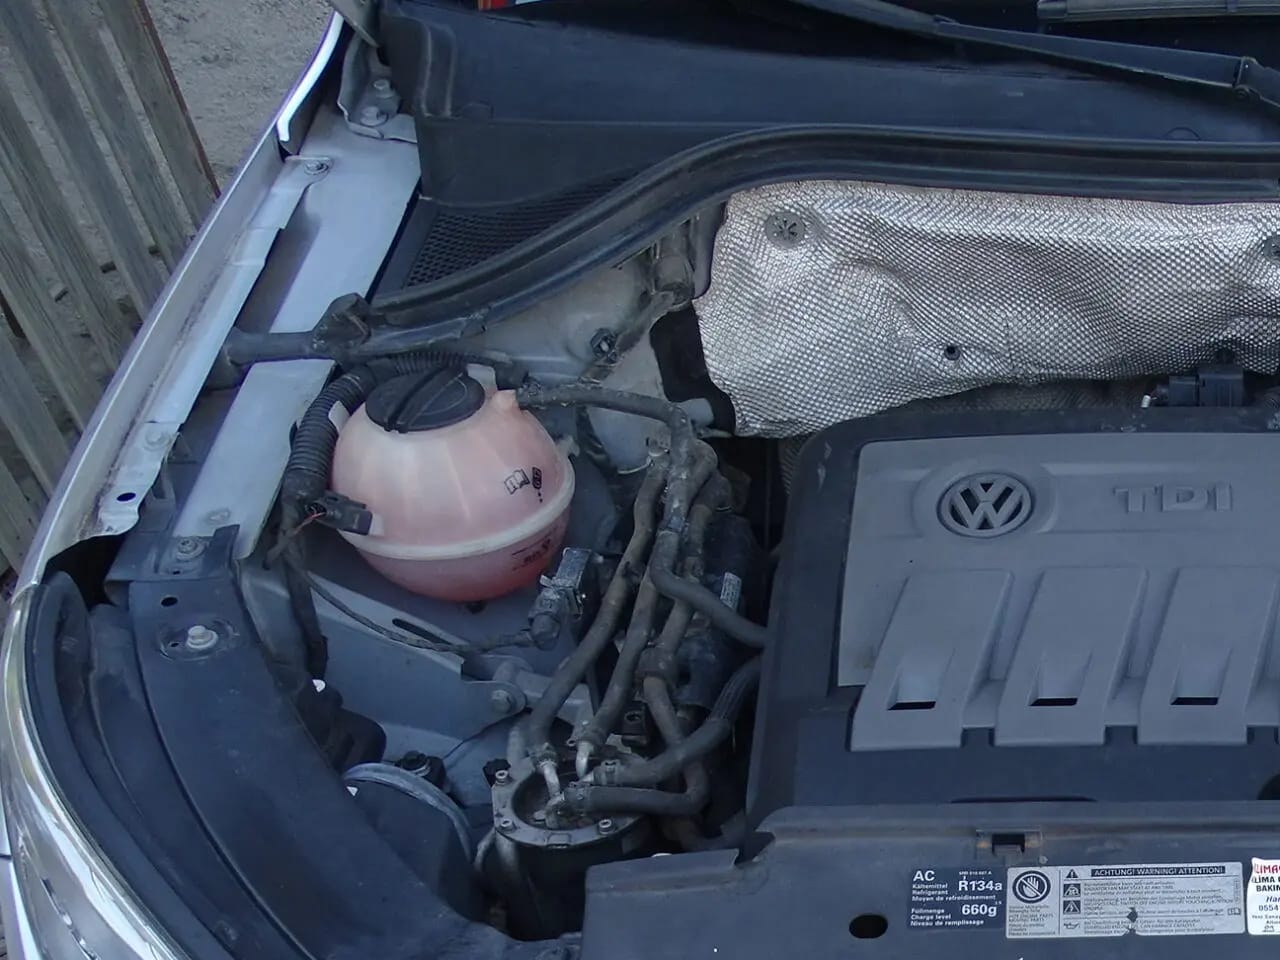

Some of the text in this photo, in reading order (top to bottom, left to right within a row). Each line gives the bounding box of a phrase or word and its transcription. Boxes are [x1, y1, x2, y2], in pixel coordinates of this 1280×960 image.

[1111, 482, 1233, 513] TDI
[913, 870, 935, 882] AC
[1094, 866, 1224, 877] ACHTUNG! WARNING! ATTENTION!
[958, 880, 1003, 892] R134a
[961, 903, 998, 918] 660g
